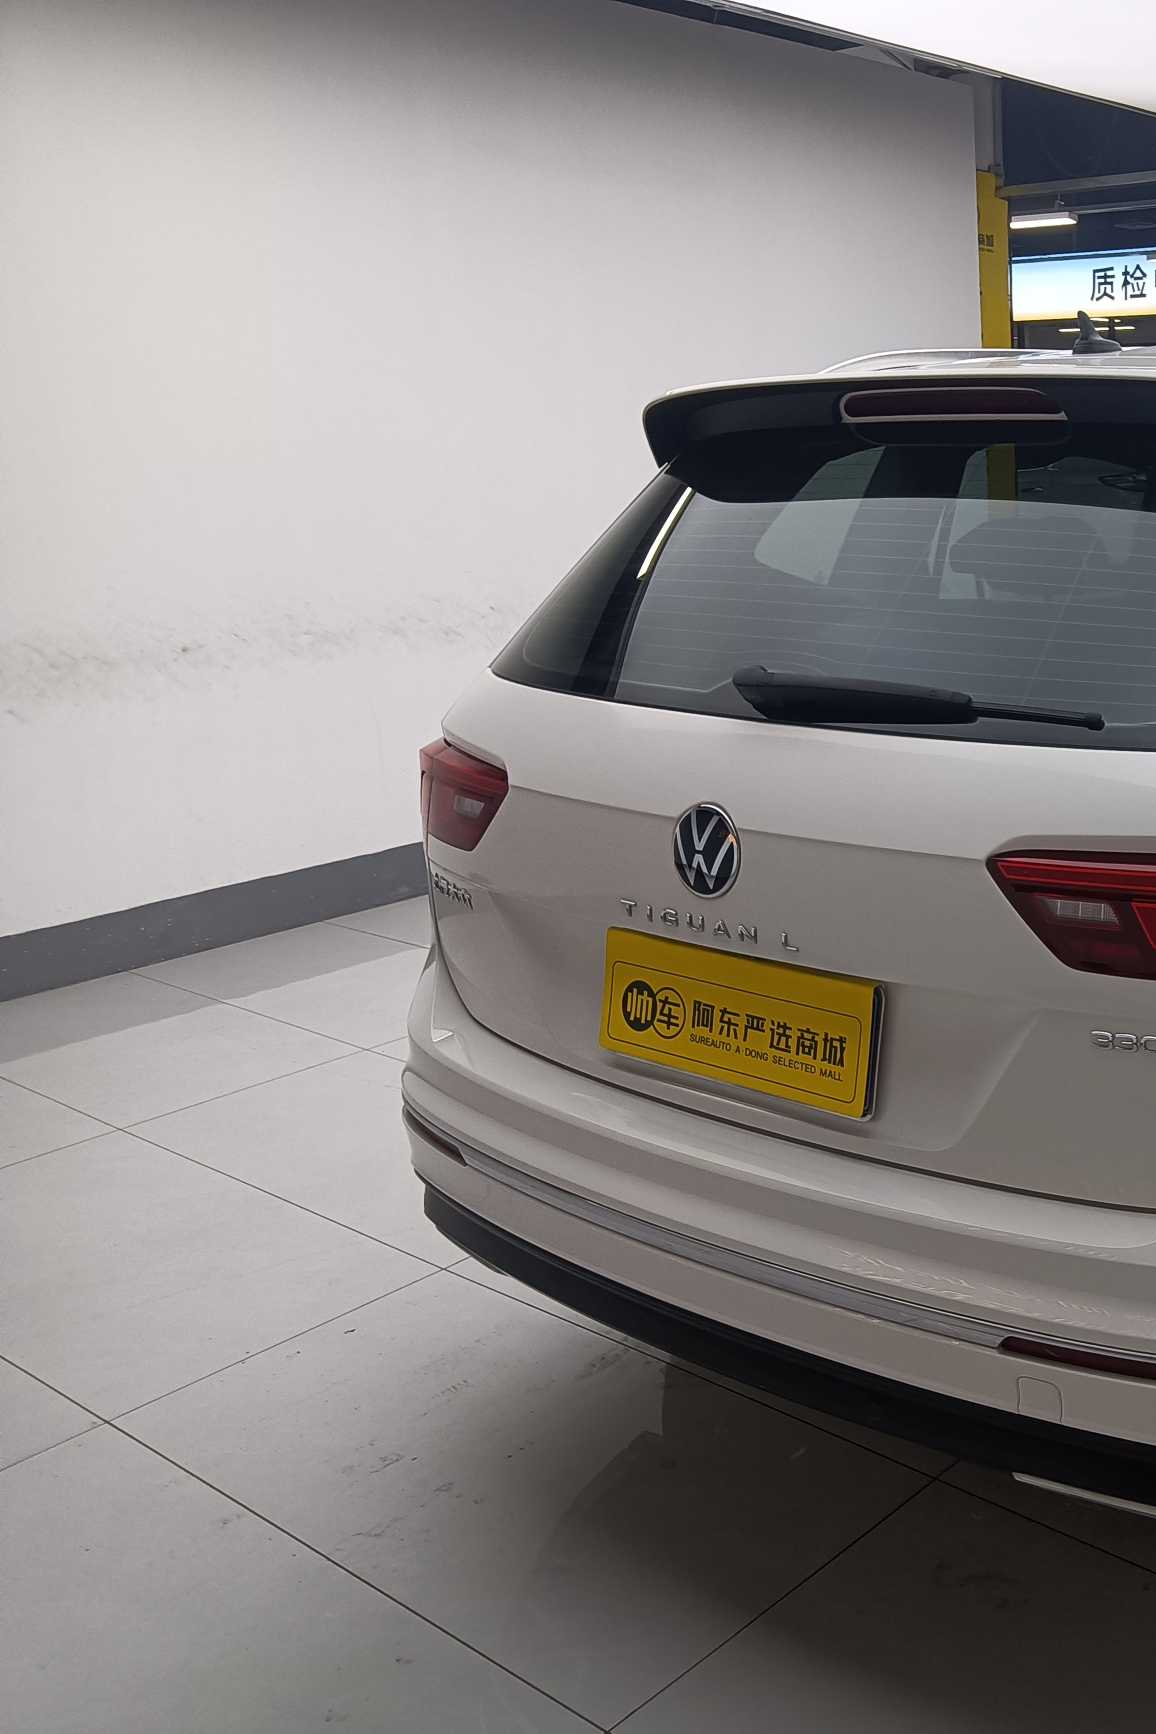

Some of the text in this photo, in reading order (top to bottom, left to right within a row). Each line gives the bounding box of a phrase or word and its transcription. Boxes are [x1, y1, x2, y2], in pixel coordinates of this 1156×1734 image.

[620, 898, 800, 952] TIGUAN L
[689, 1032, 732, 1053] SUREAUTO
[771, 1054, 817, 1075] SELECTED
[819, 1067, 844, 1083] MALL
[691, 998, 848, 1069] 阿东严选商城
